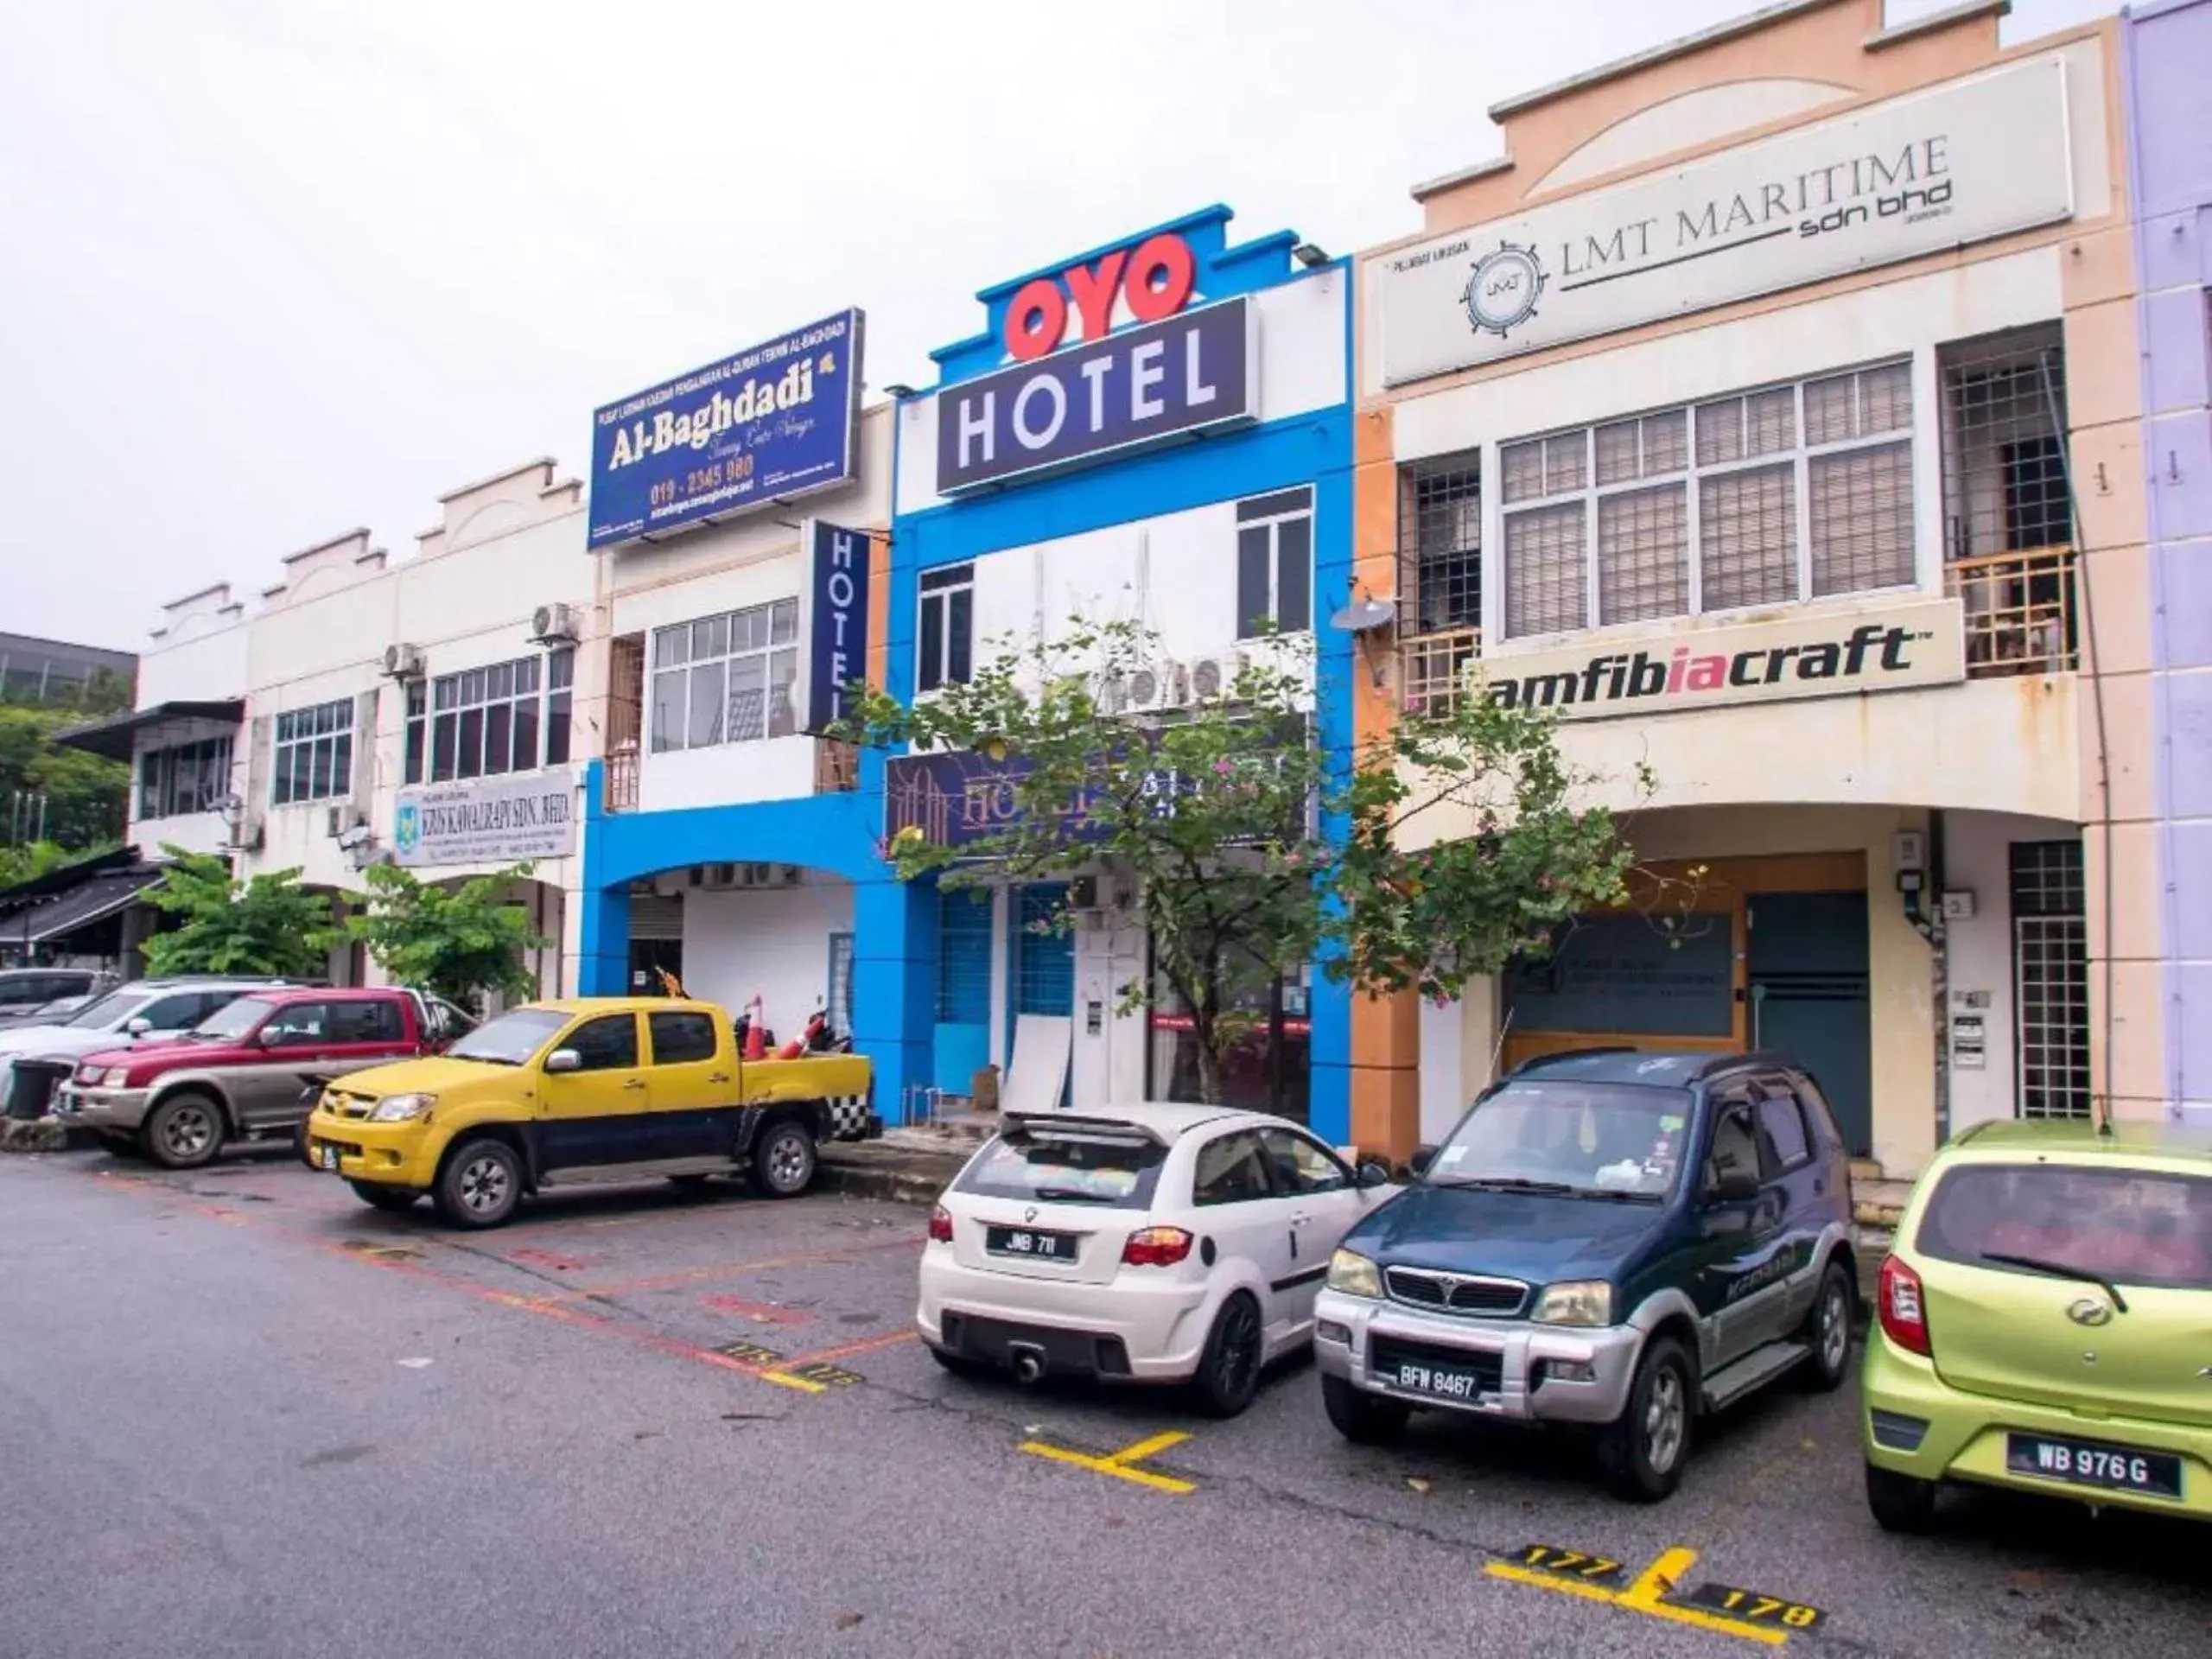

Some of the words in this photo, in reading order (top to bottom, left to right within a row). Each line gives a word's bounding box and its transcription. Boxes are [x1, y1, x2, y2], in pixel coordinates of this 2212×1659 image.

[1562, 218, 1658, 276] LMT
[1676, 135, 1948, 247] MARITIME
[1799, 206, 1867, 238] sdn
[1877, 179, 1952, 218] bhd
[1004, 232, 1195, 362] OYO
[609, 358, 814, 471] Al-Baghdadi
[957, 328, 1216, 468] HOTEL
[651, 479, 675, 505] 019
[1488, 625, 1916, 709] amfibiacraft
[2037, 1442, 2071, 1470] WB
[2076, 1449, 2126, 1480] 976
[2129, 1457, 2148, 1484] G
[1724, 1591, 1817, 1627] 178
